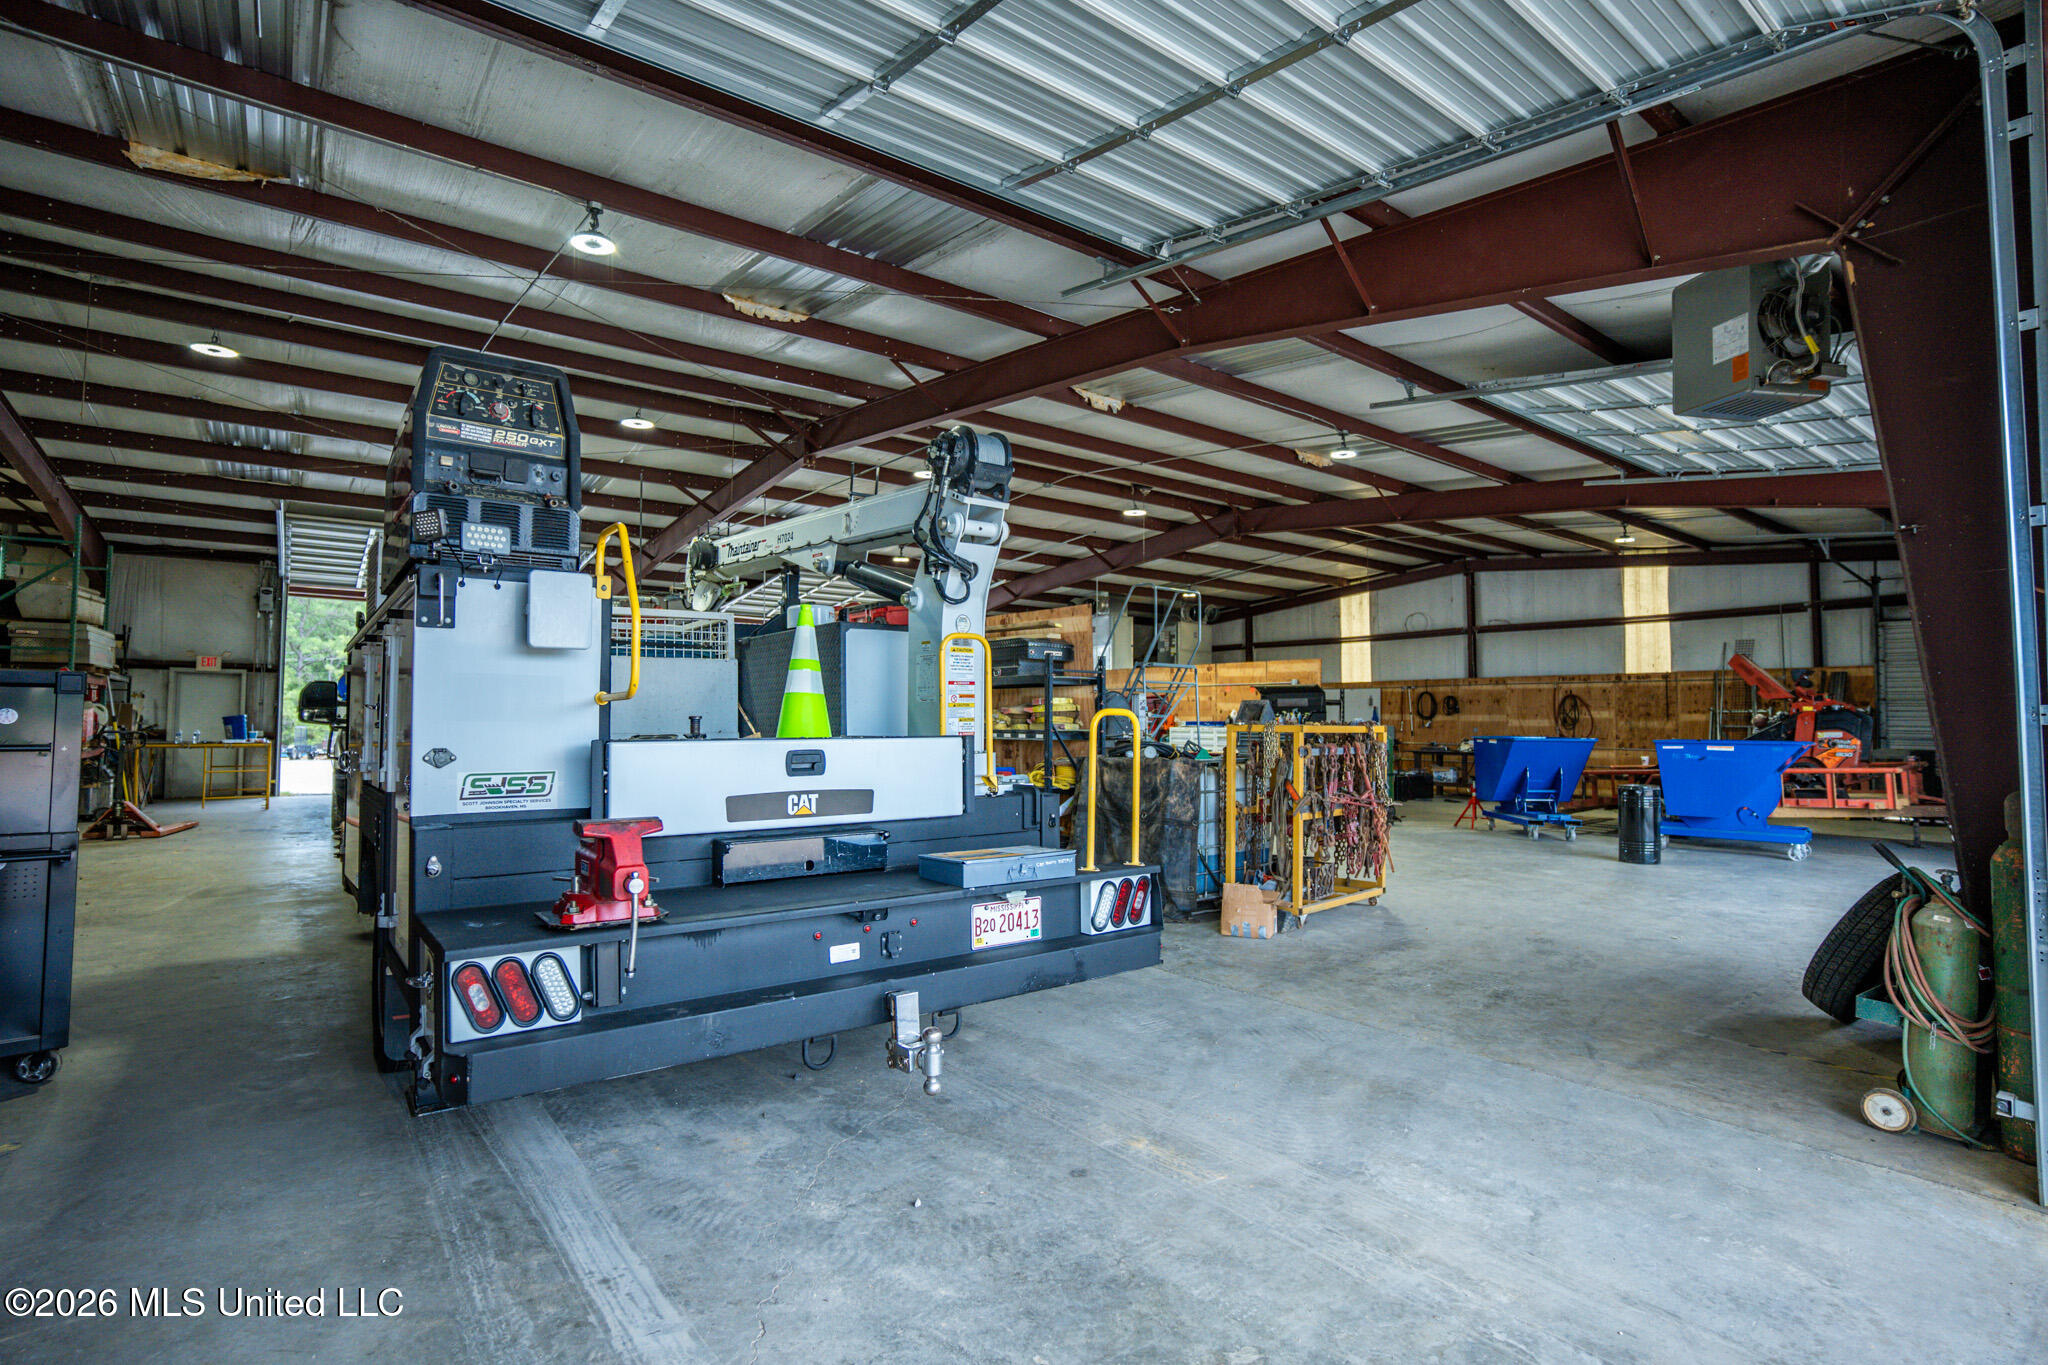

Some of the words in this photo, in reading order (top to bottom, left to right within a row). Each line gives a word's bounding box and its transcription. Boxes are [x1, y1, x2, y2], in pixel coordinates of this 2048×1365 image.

[493, 438, 528, 448] RANGER
[494, 429, 529, 442] 250
[529, 436, 556, 448] GXT
[777, 531, 794, 544] H7024
[201, 656, 216, 667] EXIT
[787, 793, 819, 815] CAT
[999, 908, 1039, 933] 20413
